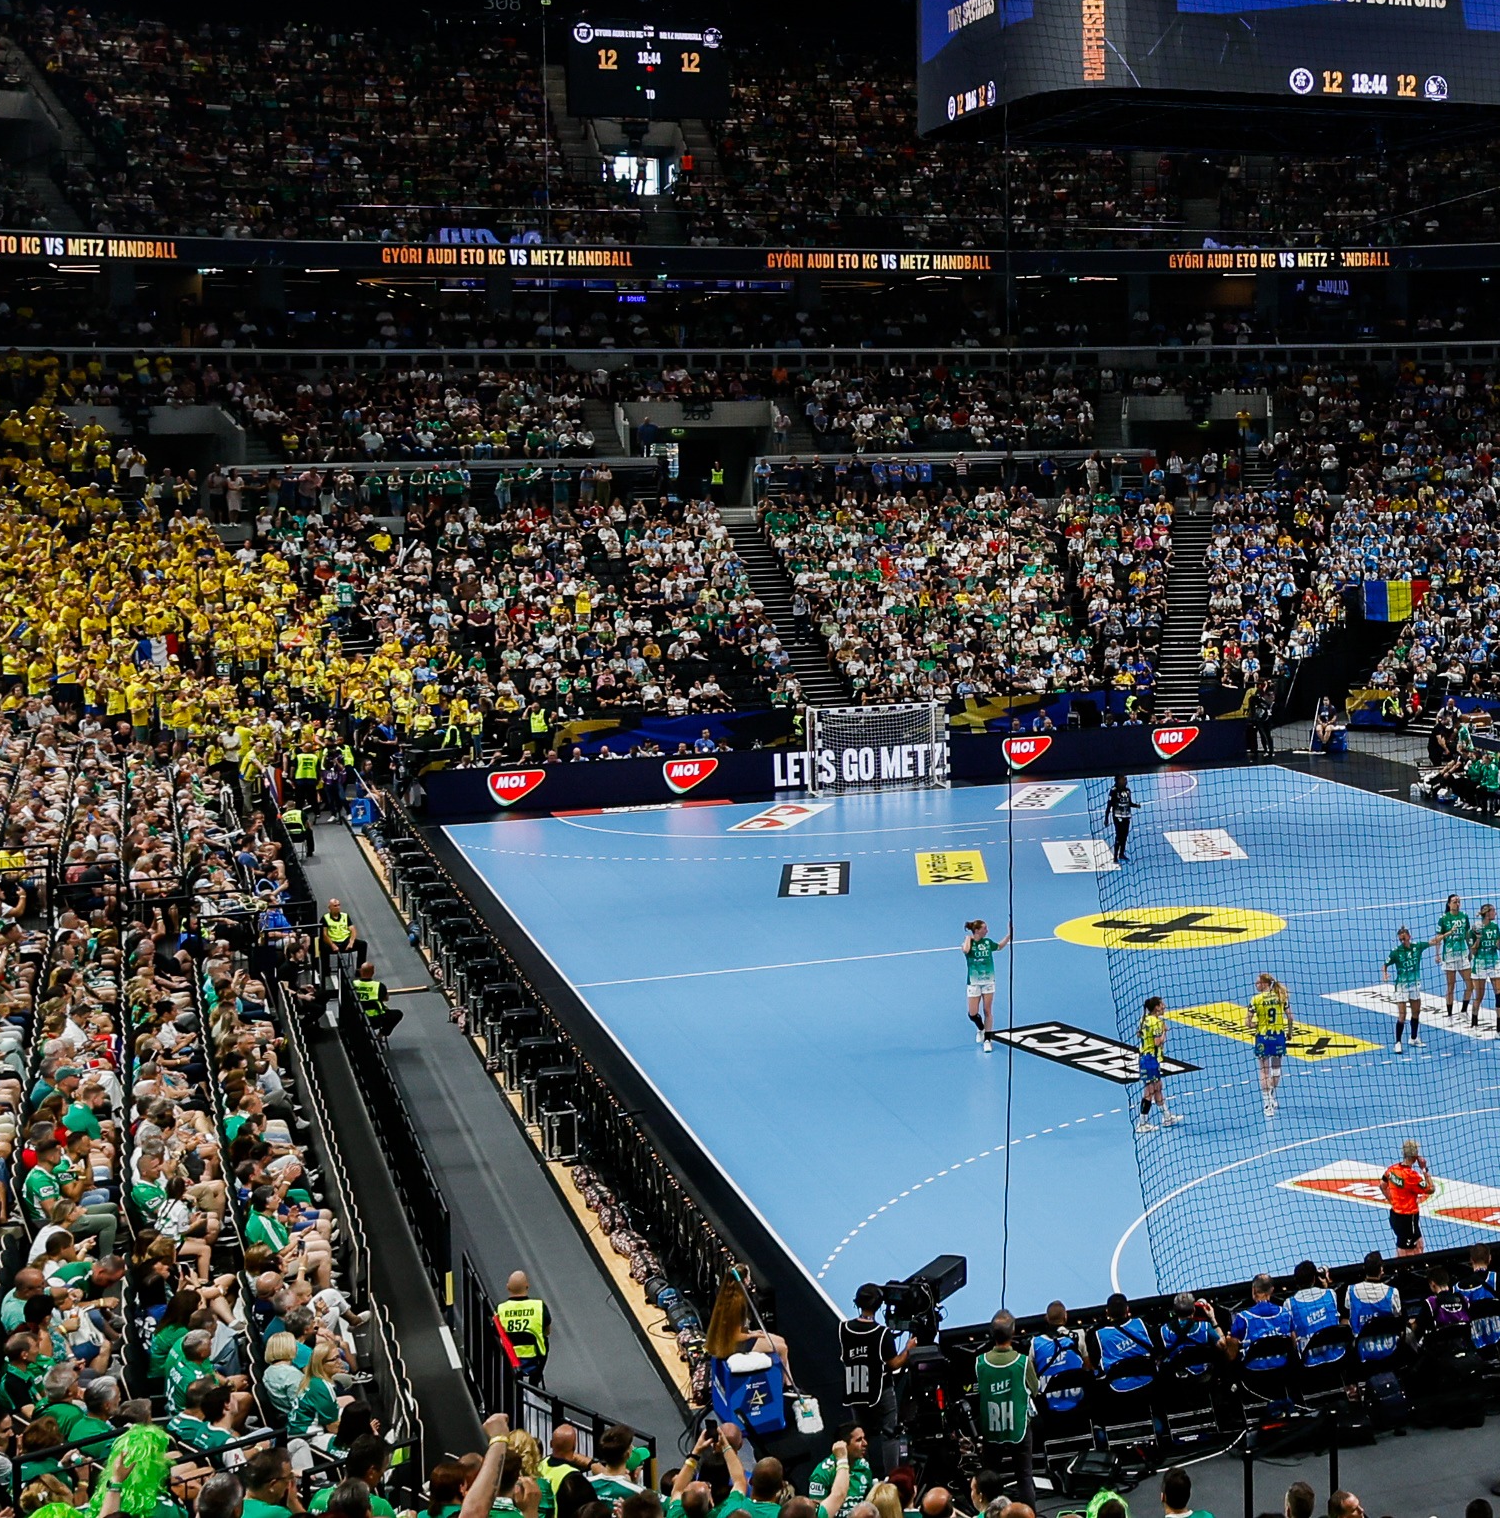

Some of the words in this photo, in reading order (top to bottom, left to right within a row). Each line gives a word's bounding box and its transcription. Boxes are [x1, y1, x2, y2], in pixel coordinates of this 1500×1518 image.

[598, 49, 618, 70] 12
[638, 52, 661, 65] 18:44
[681, 52, 701, 73] 12
[1323, 71, 1343, 93] 12
[1352, 74, 1388, 95] 18:44
[1397, 74, 1417, 97] 12
[21, 237, 40, 254] KC
[44, 237, 64, 255] VS
[68, 238, 104, 256] METZ
[108, 240, 177, 258] HANDBALL
[427, 248, 456, 264] AUDI
[461, 249, 484, 264] ETO
[488, 249, 505, 265] KC
[510, 249, 527, 265] VS
[531, 250, 564, 265] METZ
[568, 250, 632, 266] HANDBALL
[808, 254, 834, 268] AUDI
[838, 254, 858, 268] ETO
[863, 254, 877, 269] KC
[881, 254, 897, 269] VS
[900, 255, 929, 269] METZ
[933, 255, 990, 269] HANDBALL
[1208, 254, 1233, 268] AUDI
[1237, 253, 1257, 268] ETO
[1261, 253, 1275, 267] KC
[1279, 253, 1294, 267] VS
[1298, 253, 1327, 267] METZ
[1331, 252, 1389, 266] NDBALL
[1159, 732, 1184, 745] MOL
[1011, 741, 1035, 754] MOL
[671, 764, 701, 778] MOL
[842, 747, 875, 782] GO
[495, 775, 526, 789] MOL
[1267, 1007, 1277, 1024] 9
[507, 1318, 530, 1332] 852
[849, 1345, 869, 1360] EHF
[990, 1380, 1012, 1395] EHF
[987, 1401, 1015, 1432] RH
